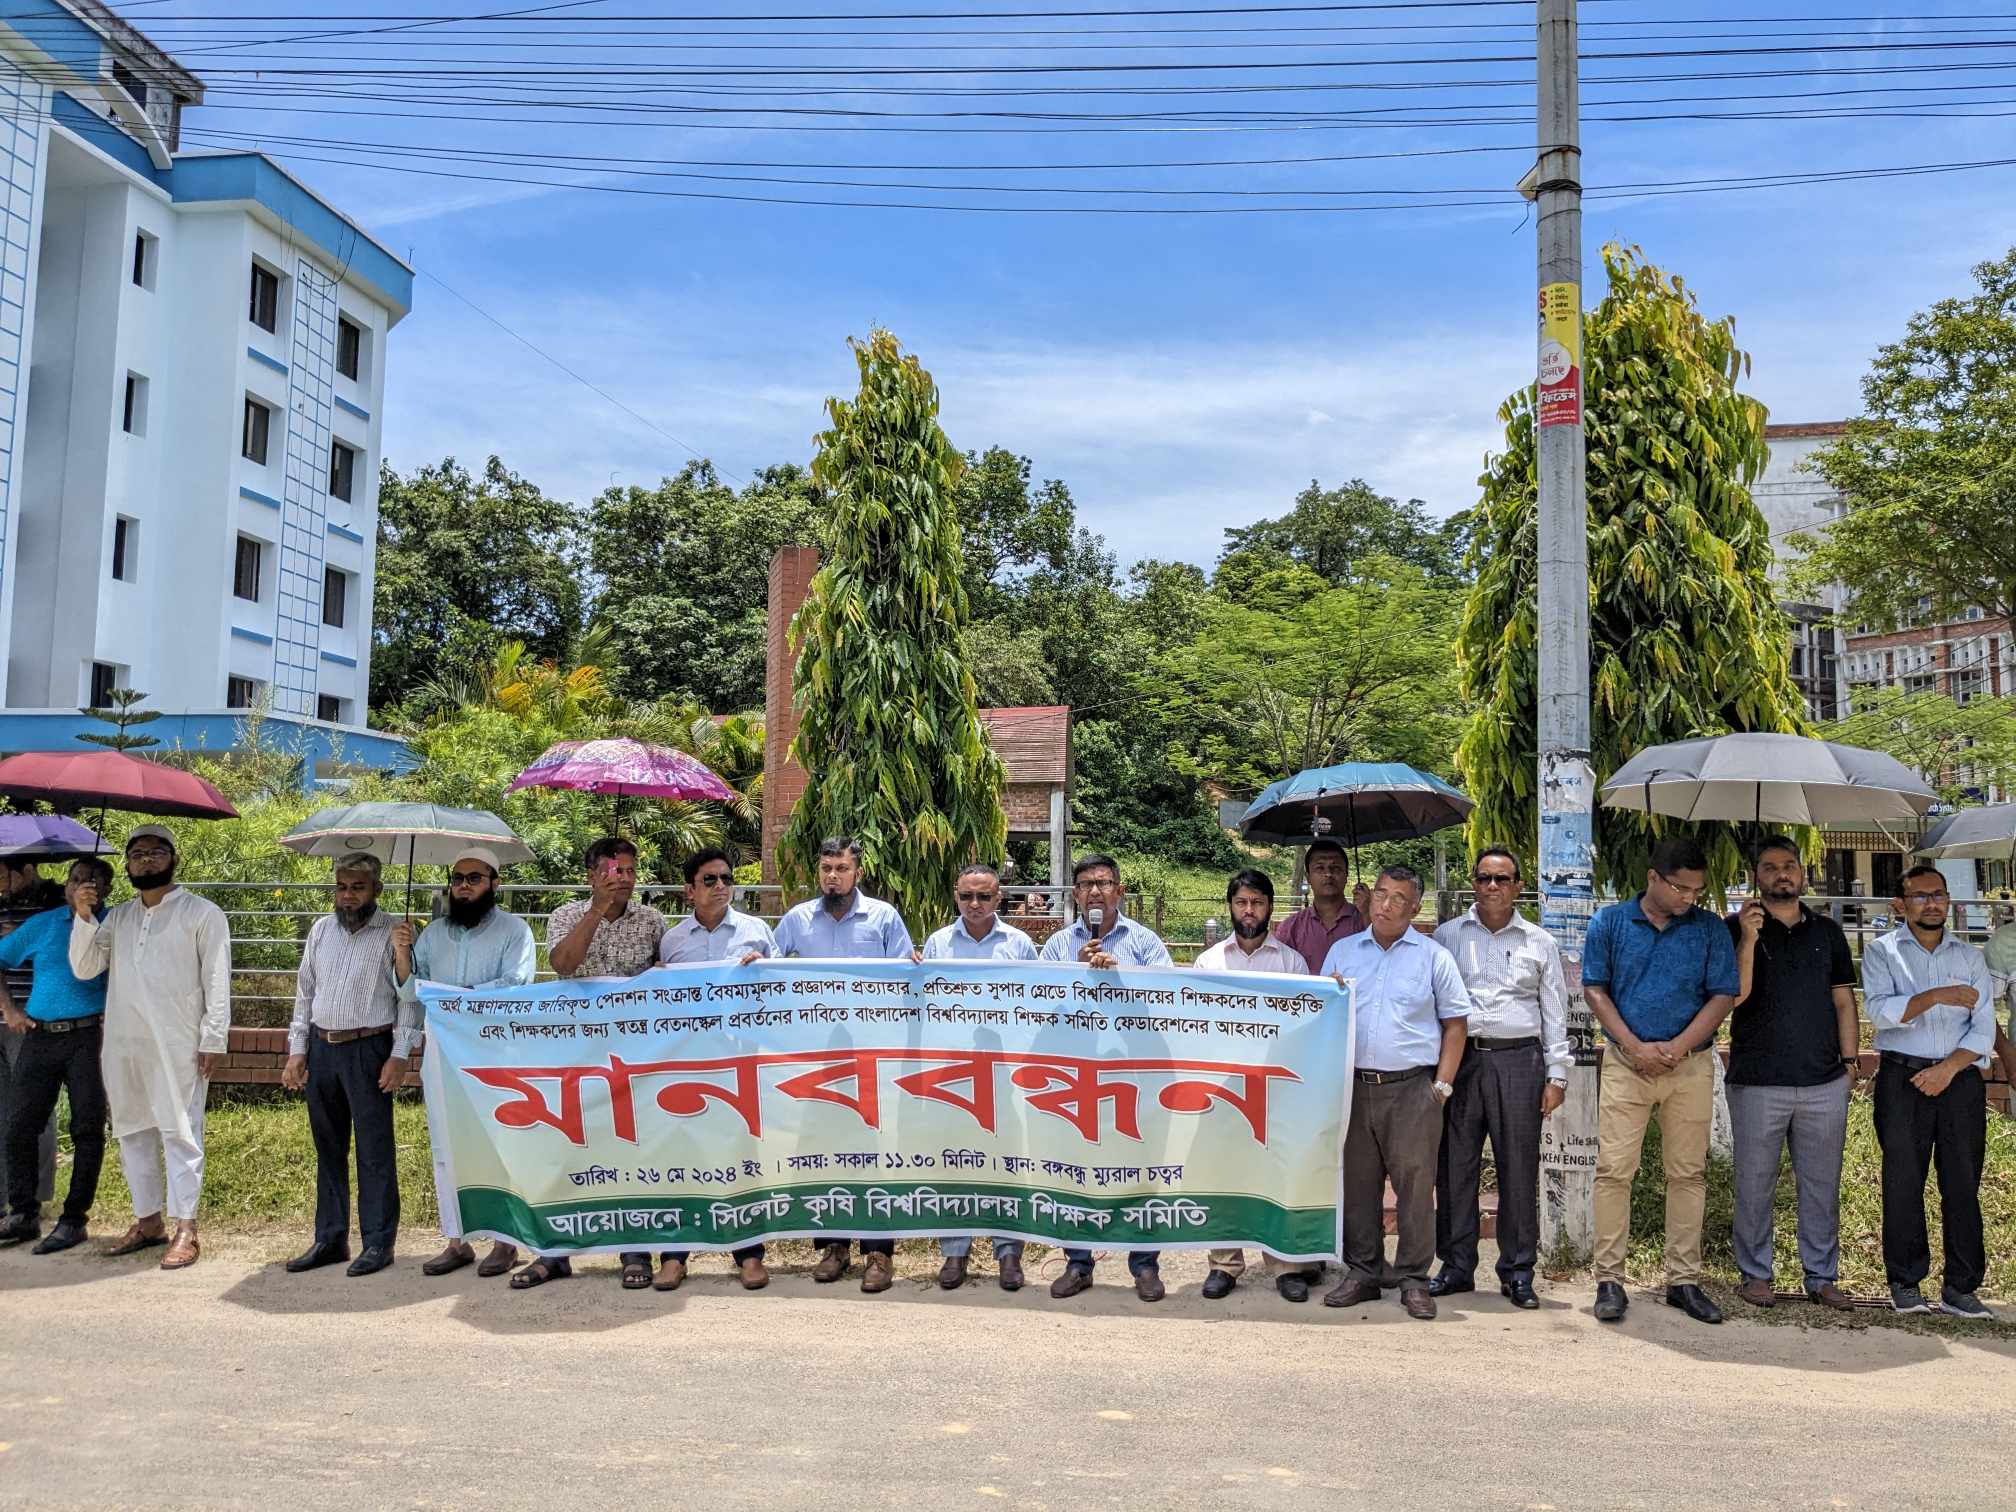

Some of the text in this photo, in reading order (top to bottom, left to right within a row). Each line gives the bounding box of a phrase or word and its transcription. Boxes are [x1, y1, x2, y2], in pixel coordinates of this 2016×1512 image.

[439, 995, 462, 1014] অর্থ
[466, 999, 533, 1015] মন্ত্রণালয়ের
[538, 995, 590, 1018] জারিকৃত
[596, 989, 648, 1009] পেনশন
[652, 986, 703, 1005] সংক্রান্ত
[706, 981, 786, 1003] বৈষম্যমূলক
[792, 979, 846, 996] প্রজ্ঞাপন
[922, 976, 982, 998] প্রতিশ্রুত
[988, 982, 1025, 1001] সুপার
[1030, 983, 1067, 999] গ্রেডে
[1072, 981, 1176, 1007] বিশ্ববিদ্যালয়ের
[1180, 986, 1258, 1010] শিক্ষকদের
[1263, 992, 1324, 1018] অন্তর্ভুক্তি
[479, 1003, 1280, 1041] এবং শিক্ষকদের জন্য স্বতন্ত্র বেতনস্কেল প্রবর্তনের দাবিতে বাংলাদেশ বিশ্ববিদ্যালয় শিক্ষক সমিতি ফেডারেশনের আহবানে
[458, 1047, 1304, 1148] মানববন্ধন
[568, 1164, 619, 1187] তারিখ
[637, 1167, 661, 1185] ২৬
[667, 1167, 685, 1183] মে
[691, 1166, 737, 1185] ২০২৪
[742, 1159, 763, 1178] ইং
[833, 1152, 879, 1169] সকাল
[885, 1152, 936, 1169] ১১.৩০
[941, 1148, 986, 1170] মিনিট
[1041, 1160, 1088, 1186] বঙ্গবন্ধু
[1093, 1166, 1142, 1188] ম্যুরাল
[1147, 1164, 1185, 1187] চত্বর
[546, 1207, 683, 1238] আয়োজনে
[708, 1191, 795, 1233] সিলেট
[800, 1186, 857, 1229] কৃষি
[864, 1185, 1023, 1220] বিশ্ববিদ্যালয়
[1028, 1192, 1114, 1231] শিক্ষক
[1121, 1199, 1210, 1231] সমিতি
